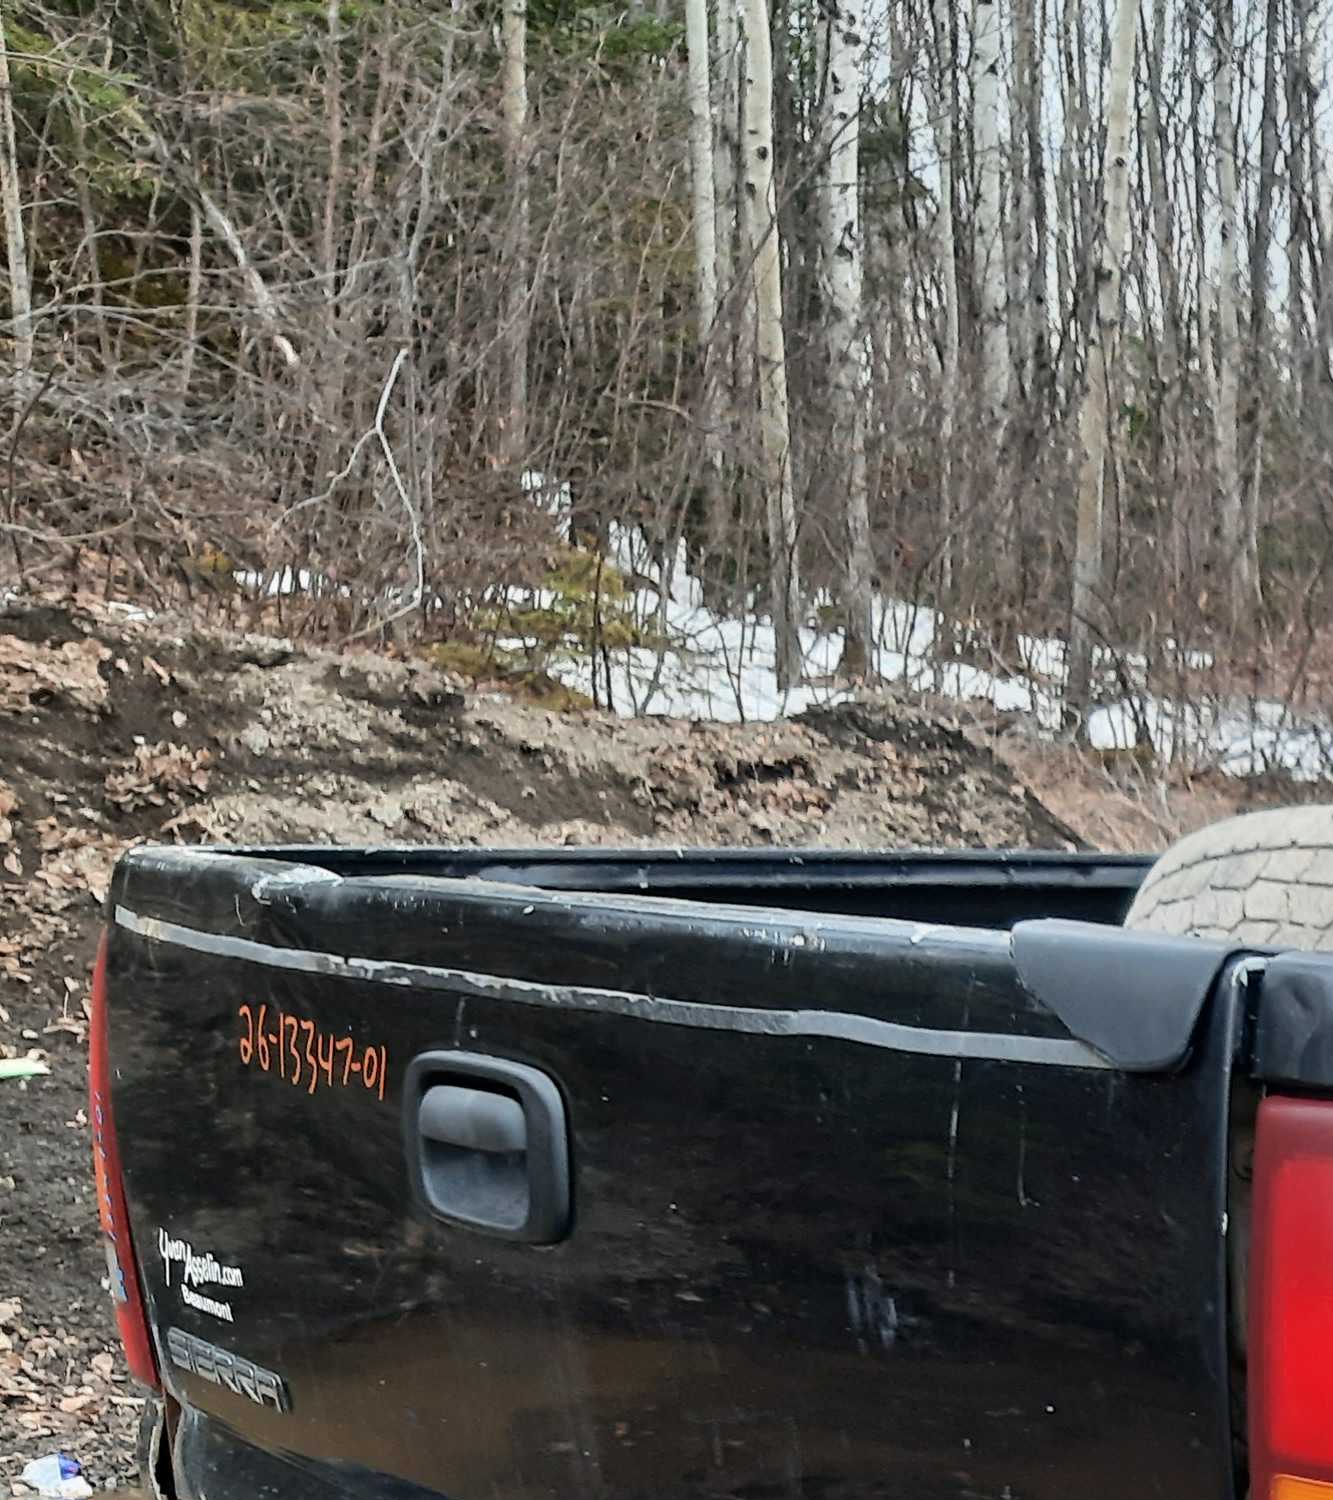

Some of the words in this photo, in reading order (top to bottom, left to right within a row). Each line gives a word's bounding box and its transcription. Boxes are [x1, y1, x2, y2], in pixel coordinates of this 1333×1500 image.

[238, 1003, 387, 1101] 26-13347-01
[180, 1283, 235, 1323] Beaumont
[167, 1326, 289, 1415] SIERRA
